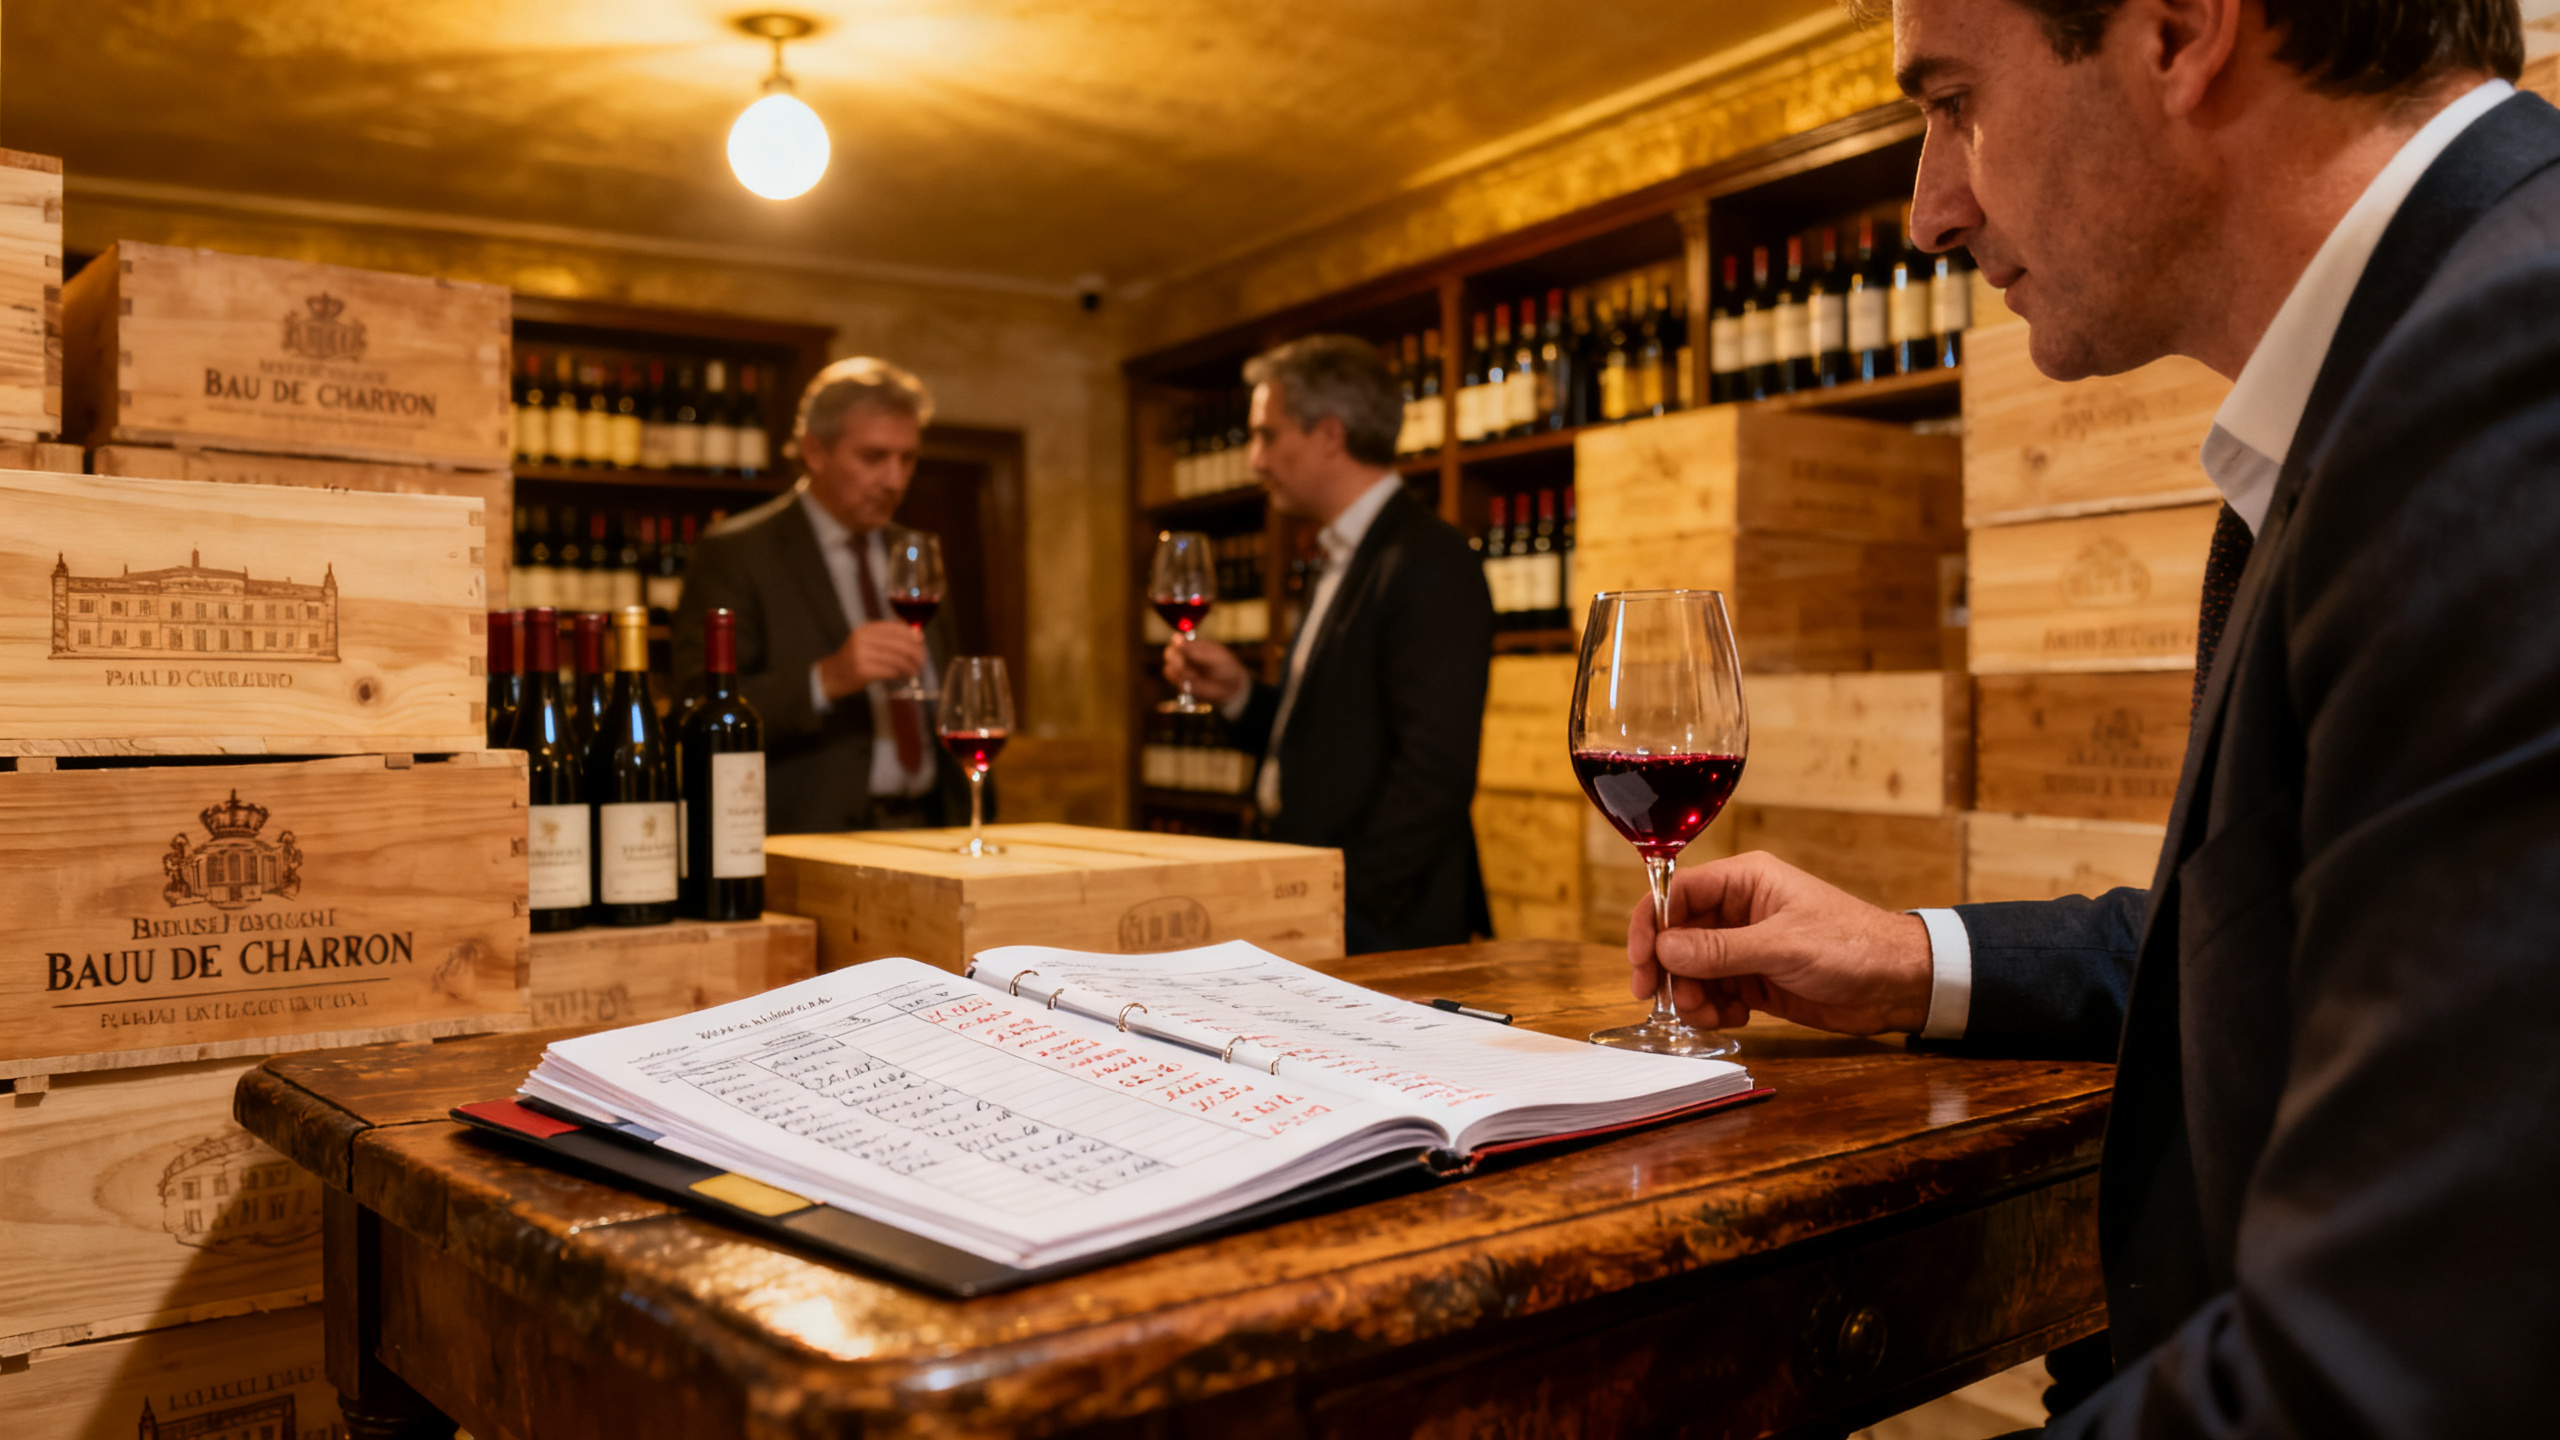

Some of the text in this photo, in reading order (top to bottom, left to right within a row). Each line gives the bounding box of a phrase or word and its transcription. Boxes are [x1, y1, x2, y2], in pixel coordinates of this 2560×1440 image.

[204, 368, 260, 400] BAU
[273, 379, 306, 405] DE
[171, 945, 222, 981] DE
[239, 931, 413, 975] CHARRON
